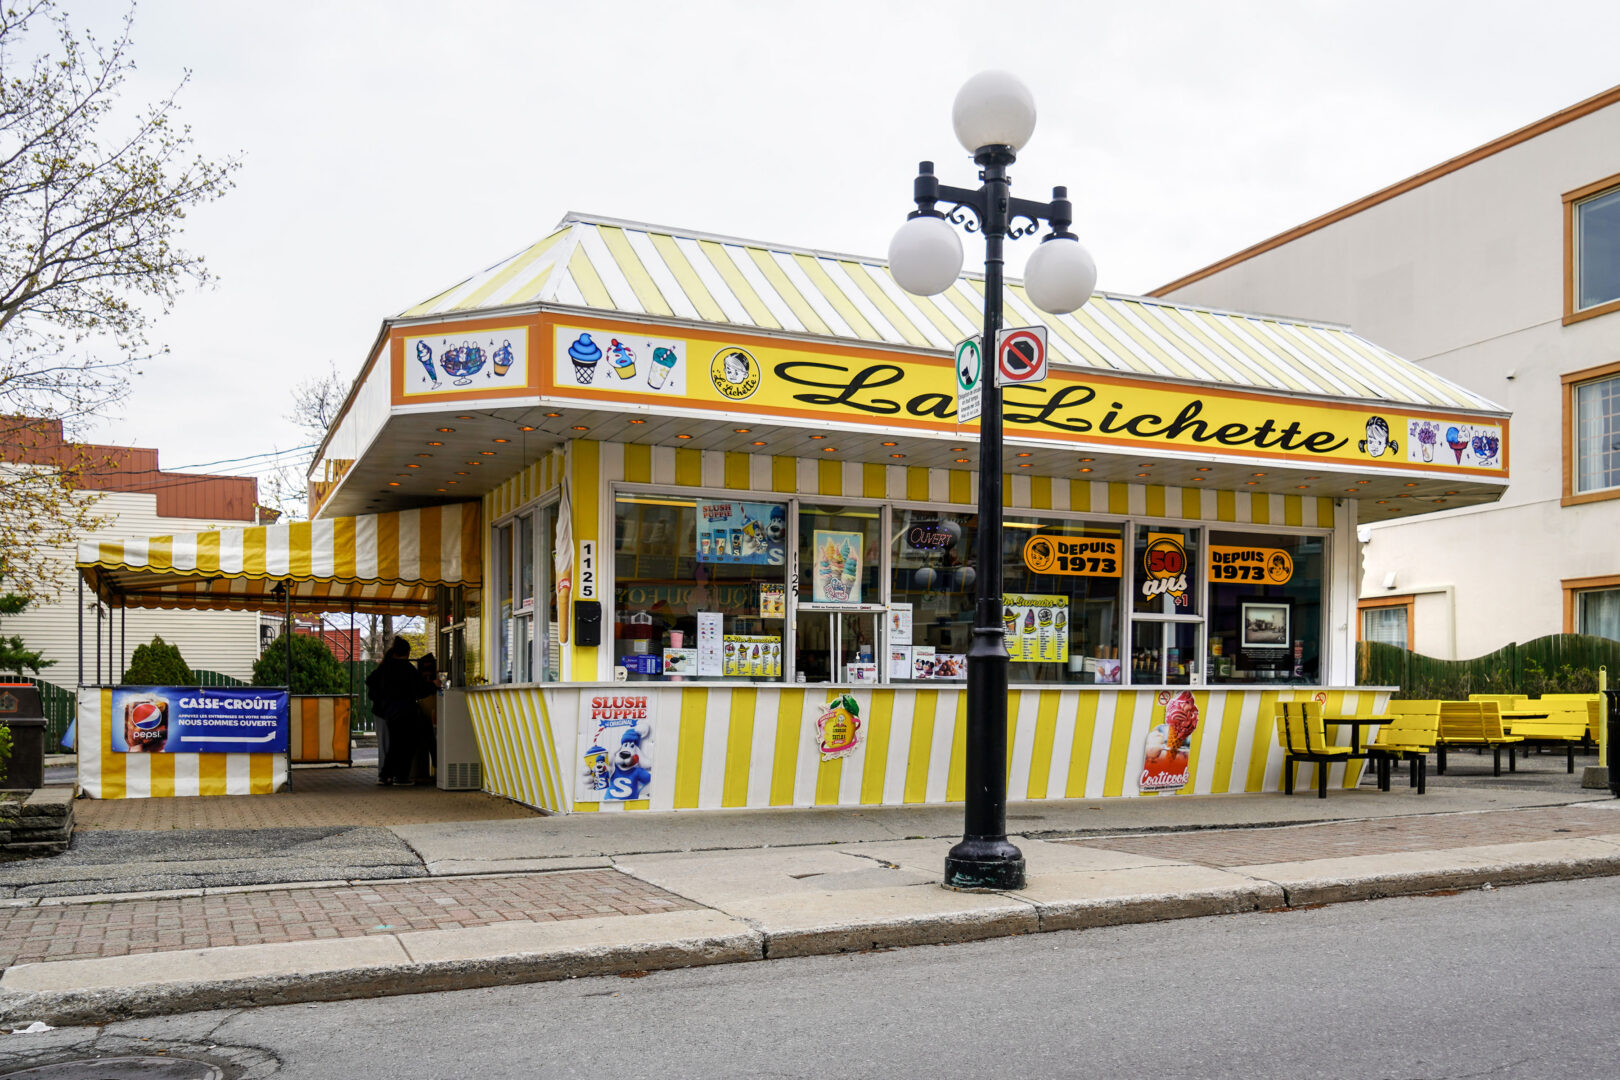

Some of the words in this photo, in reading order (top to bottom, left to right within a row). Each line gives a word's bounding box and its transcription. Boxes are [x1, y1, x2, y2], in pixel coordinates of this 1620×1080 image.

[722, 379, 757, 397] Lichette
[774, 361, 957, 418] La
[1002, 384, 1348, 453] Lichette
[703, 504, 732, 512] SLUSH
[704, 510, 733, 518] PUPPIE
[911, 528, 952, 544] OUVERT
[1058, 538, 1116, 555] DEPUIS
[1057, 556, 1116, 572] 1973
[1150, 550, 1182, 572] 50
[1212, 550, 1264, 564] DEPUIS
[583, 543, 593, 597] 1125
[1212, 565, 1264, 580] 1973
[1142, 574, 1188, 596] ans
[1174, 594, 1188, 606] +1
[179, 696, 277, 710] CASSE-CROÛTE
[592, 696, 647, 708] SLUSH
[133, 731, 160, 740] pepsi
[1140, 766, 1189, 786] Coaticook
